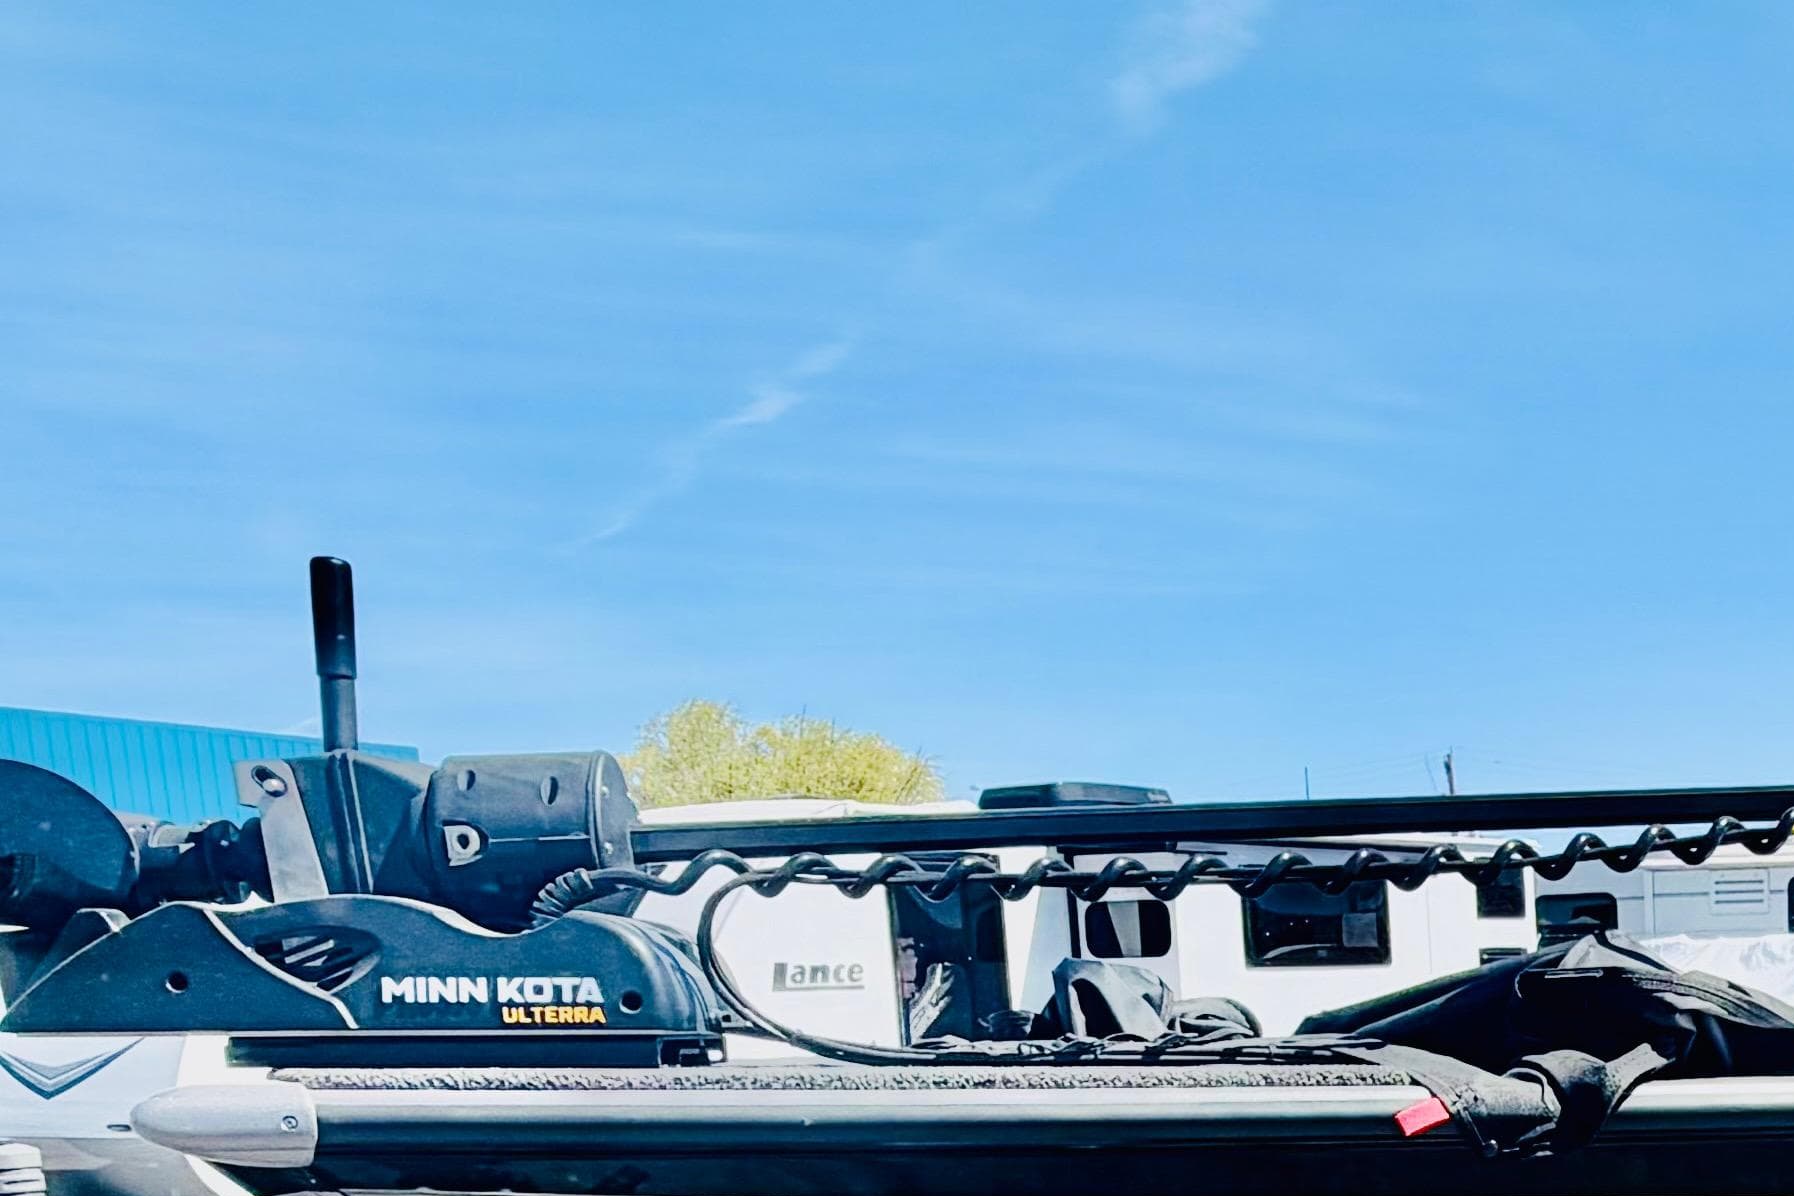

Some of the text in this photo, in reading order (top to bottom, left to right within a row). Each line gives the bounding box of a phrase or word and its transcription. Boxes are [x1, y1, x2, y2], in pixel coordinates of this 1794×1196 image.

[380, 976, 605, 1004] MINN KOTA
[771, 961, 865, 992] Lance
[501, 1005, 607, 1025] ULTERRA
